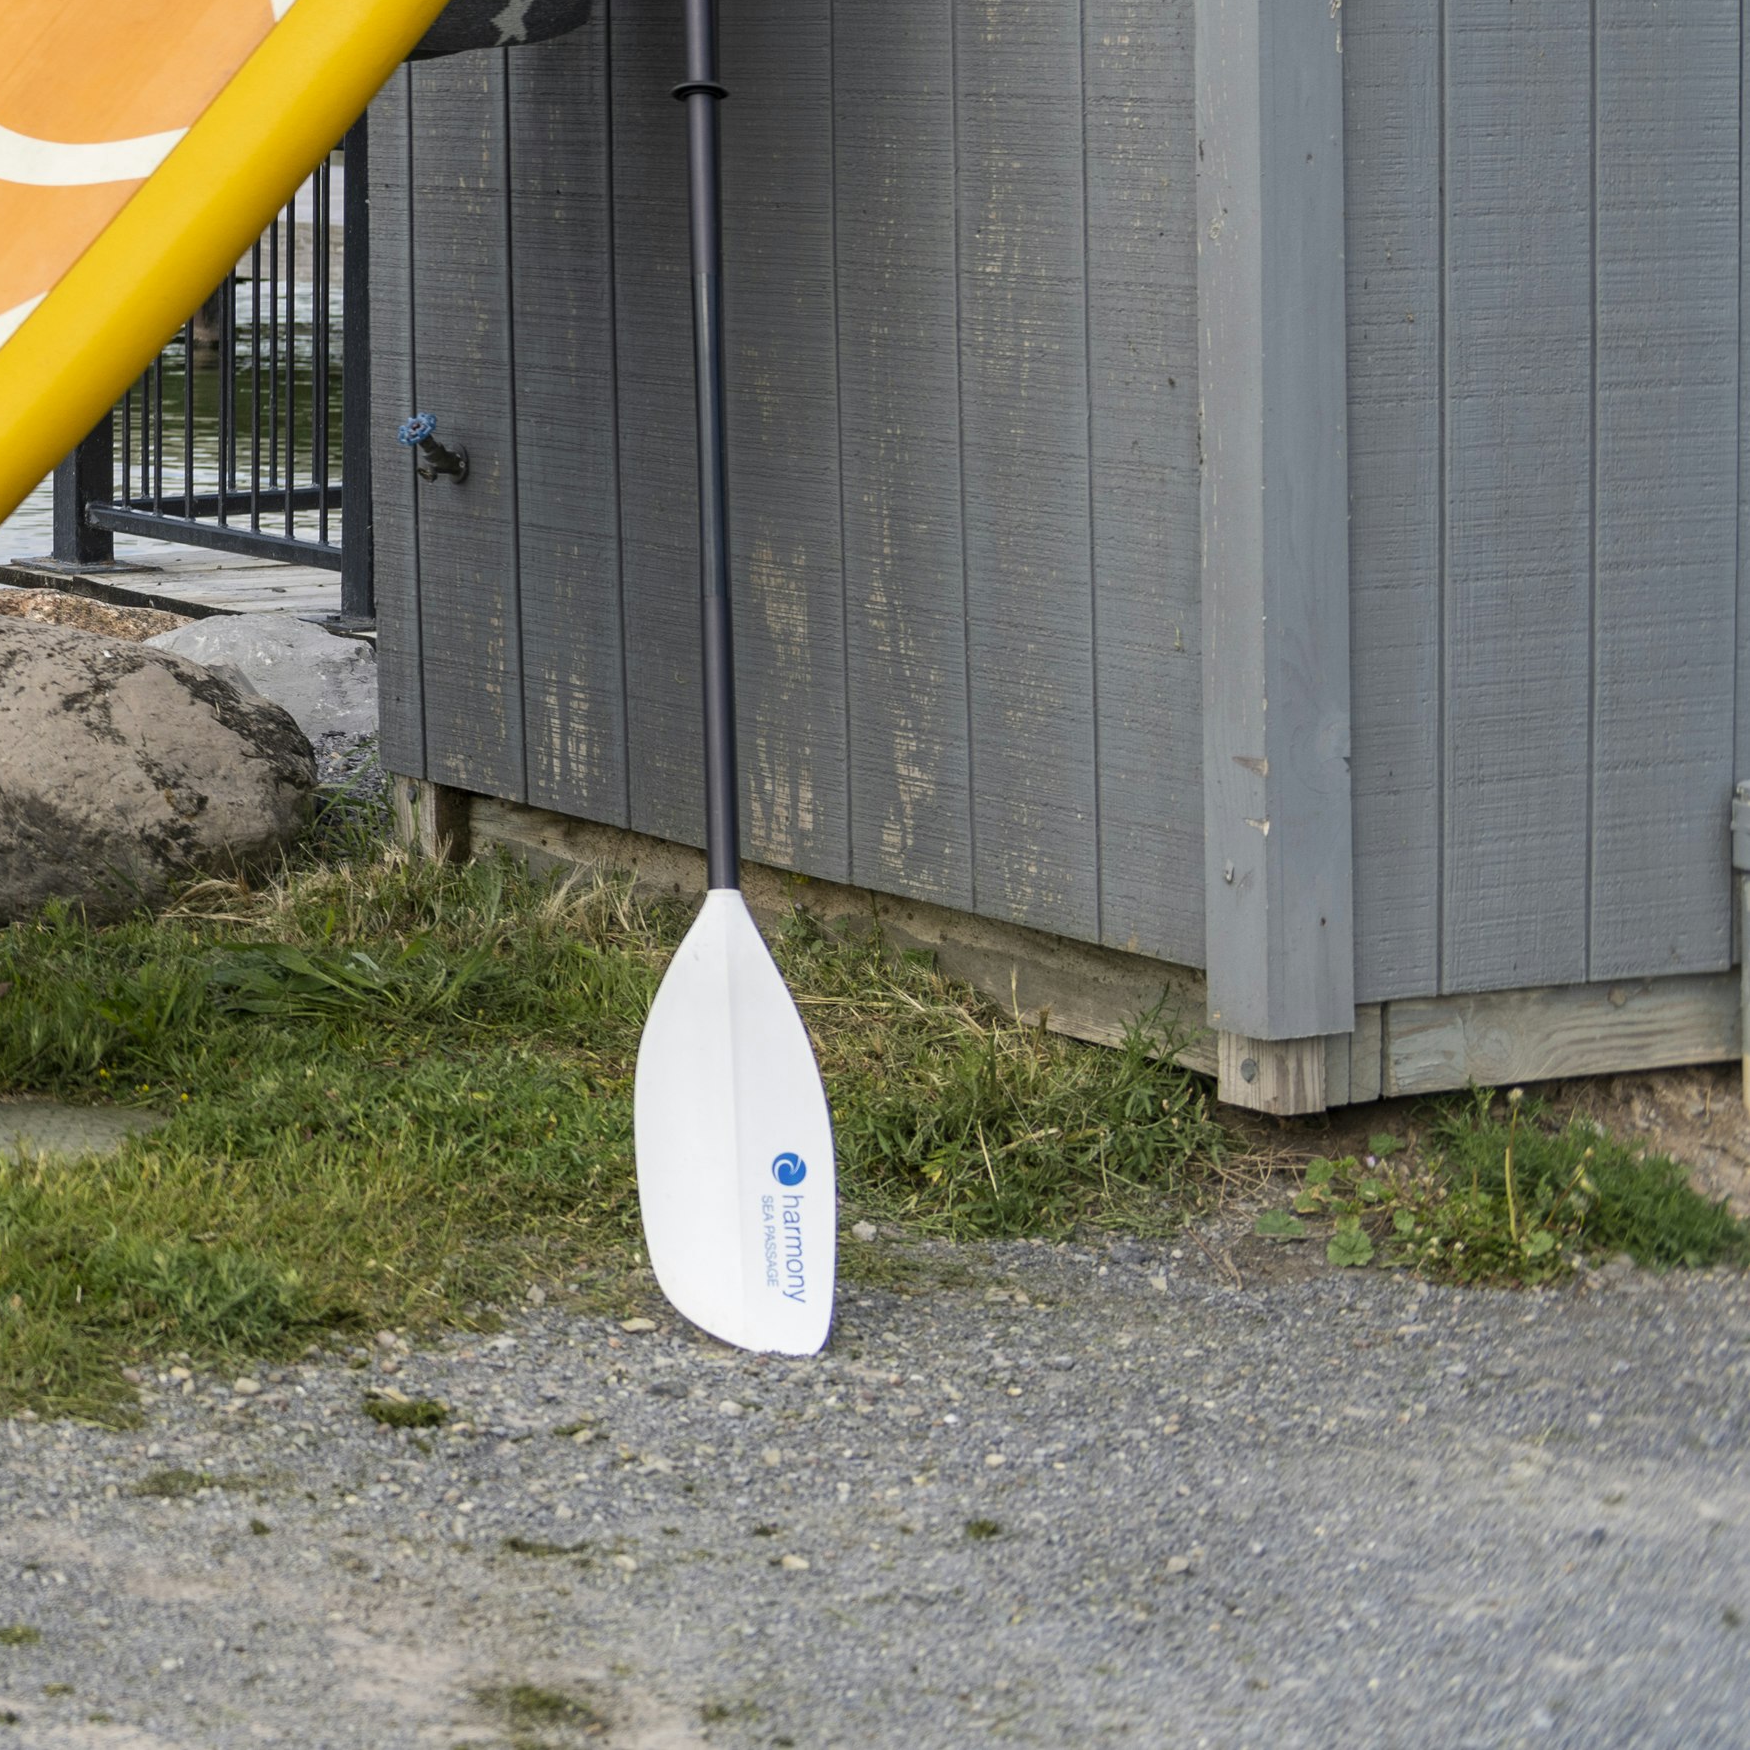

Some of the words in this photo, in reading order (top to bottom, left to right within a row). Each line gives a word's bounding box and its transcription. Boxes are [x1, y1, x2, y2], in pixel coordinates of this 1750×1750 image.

[761, 1194, 775, 1222] SEA
[764, 1225, 779, 1288] PASSAGE
[781, 1194, 807, 1304] harmony
